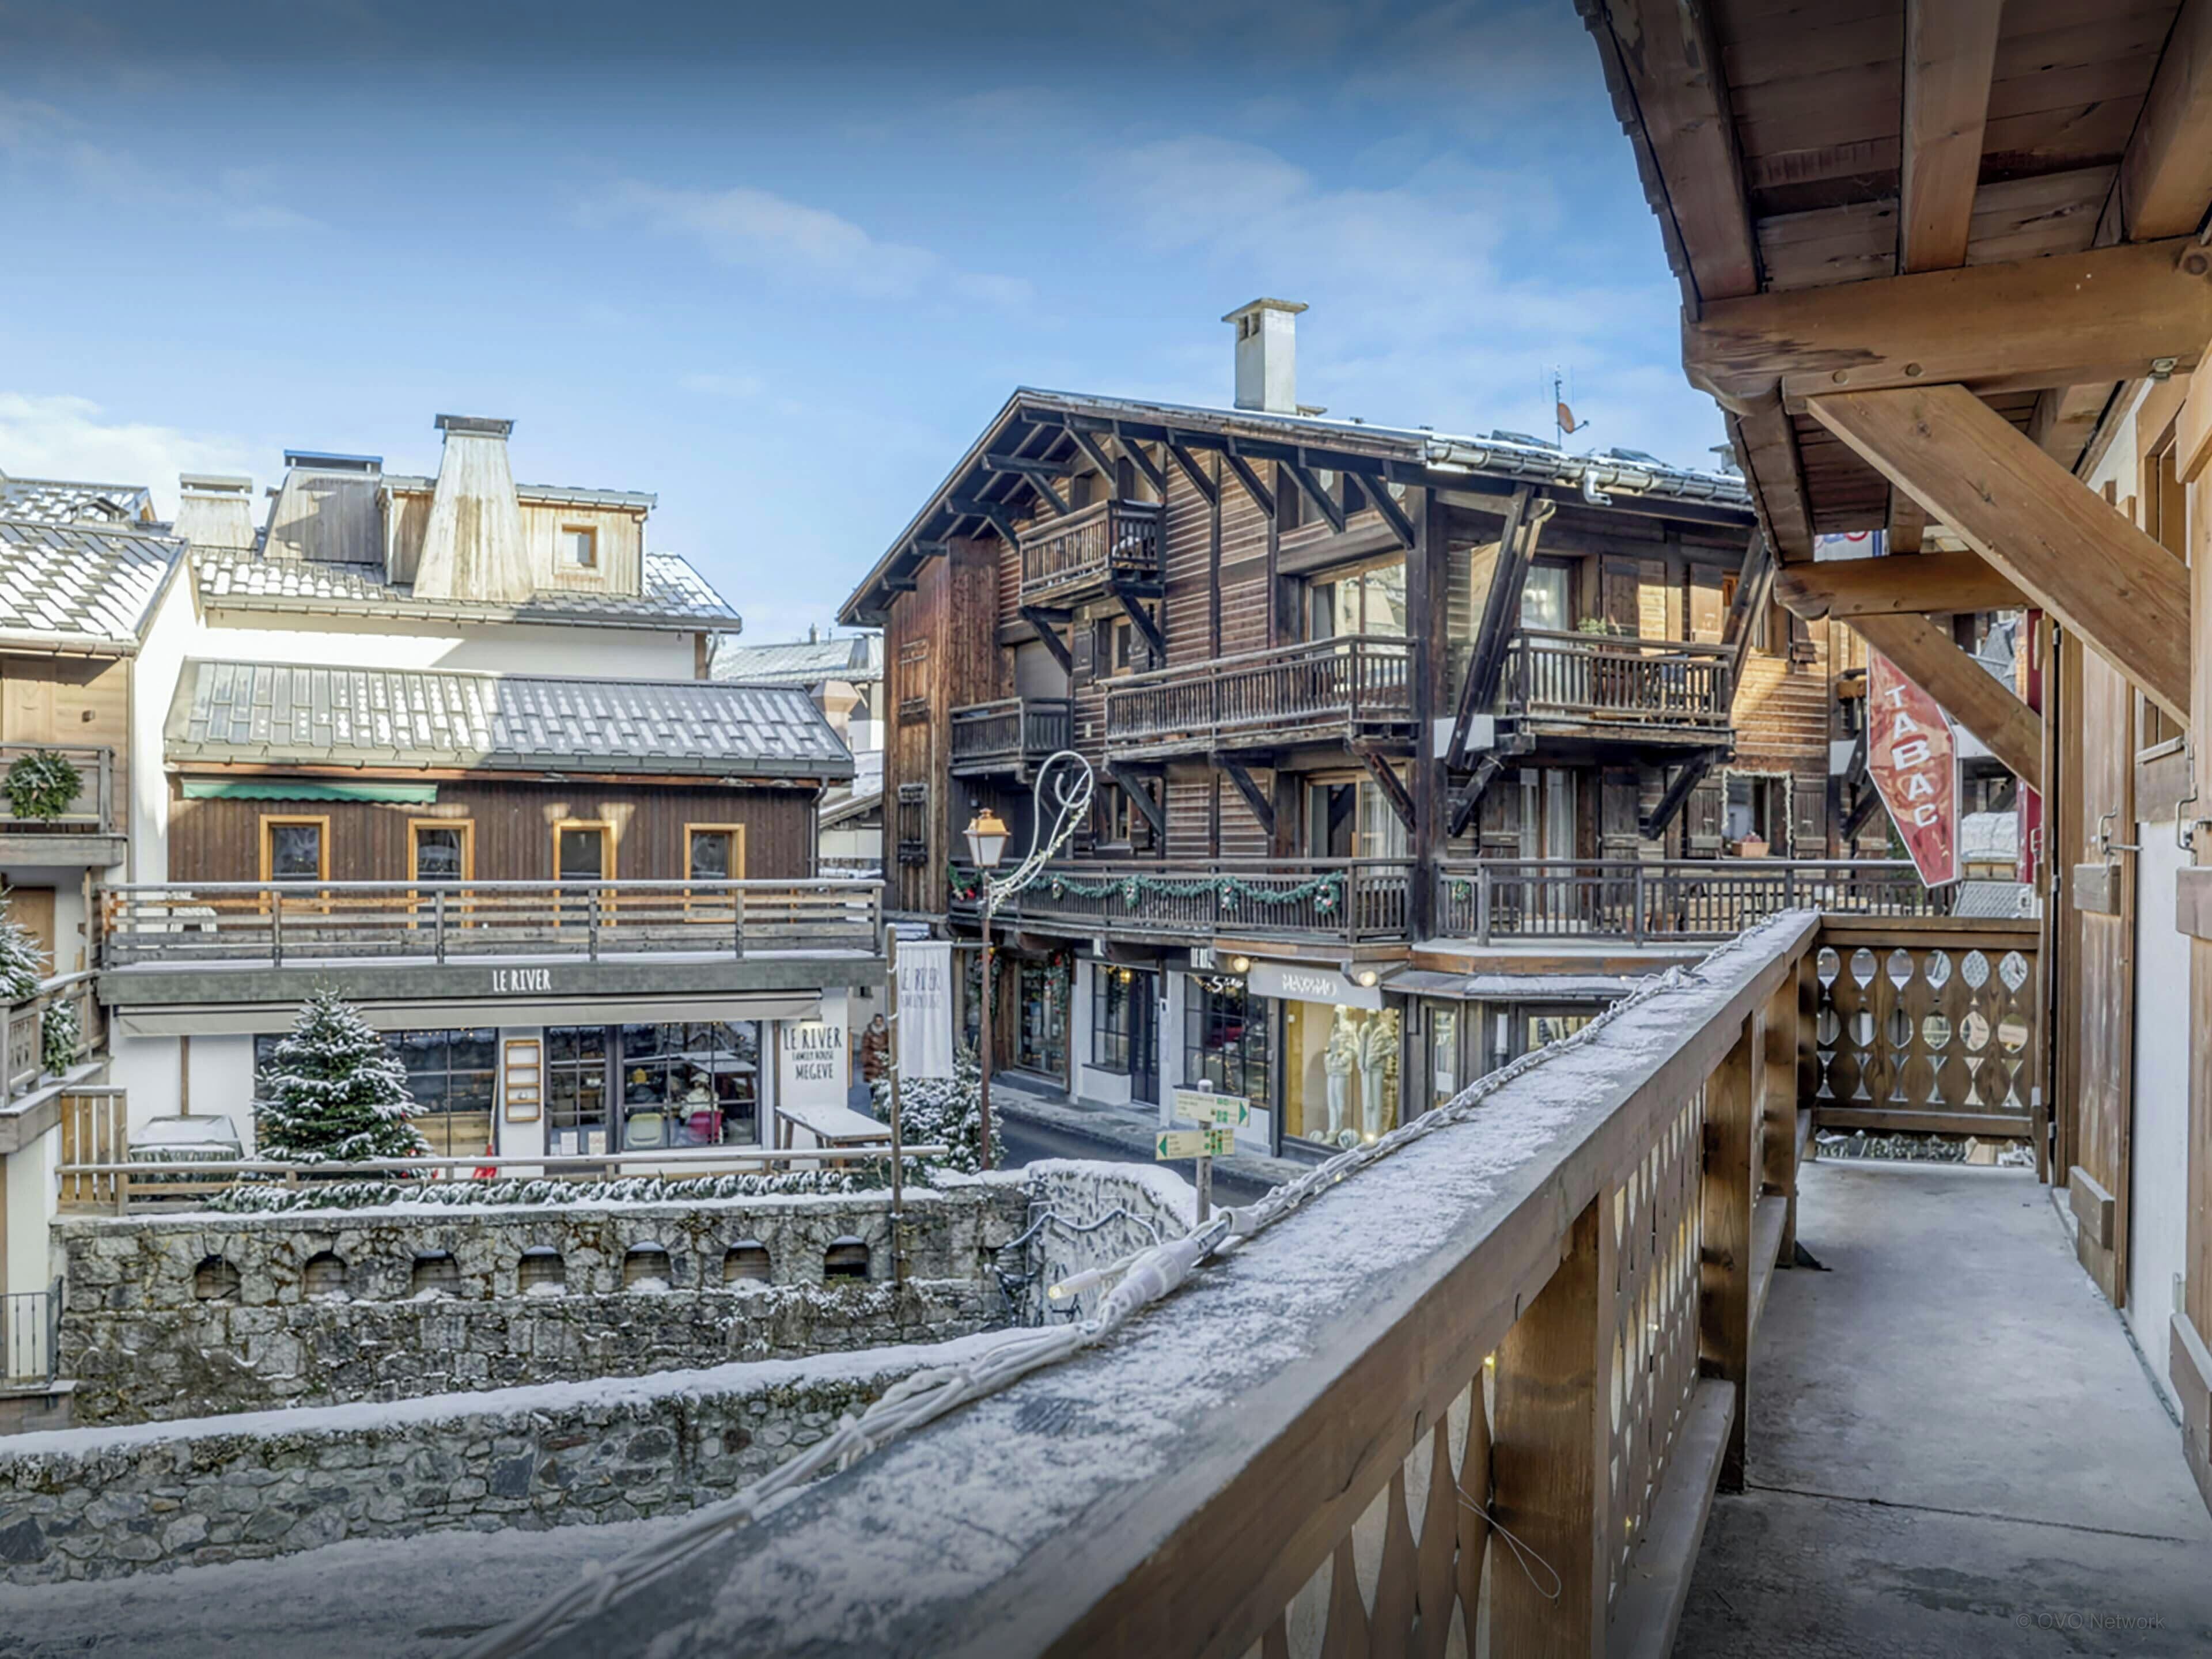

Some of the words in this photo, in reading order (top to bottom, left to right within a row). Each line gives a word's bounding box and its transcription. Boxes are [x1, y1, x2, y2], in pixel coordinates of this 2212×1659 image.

[1884, 684, 1939, 828] TABAC
[493, 969, 507, 991] LE
[511, 968, 551, 991] RIVER
[783, 1028, 797, 1050] LE
[802, 1027, 842, 1049] RIVER
[796, 1063, 834, 1080] MEGEVE
